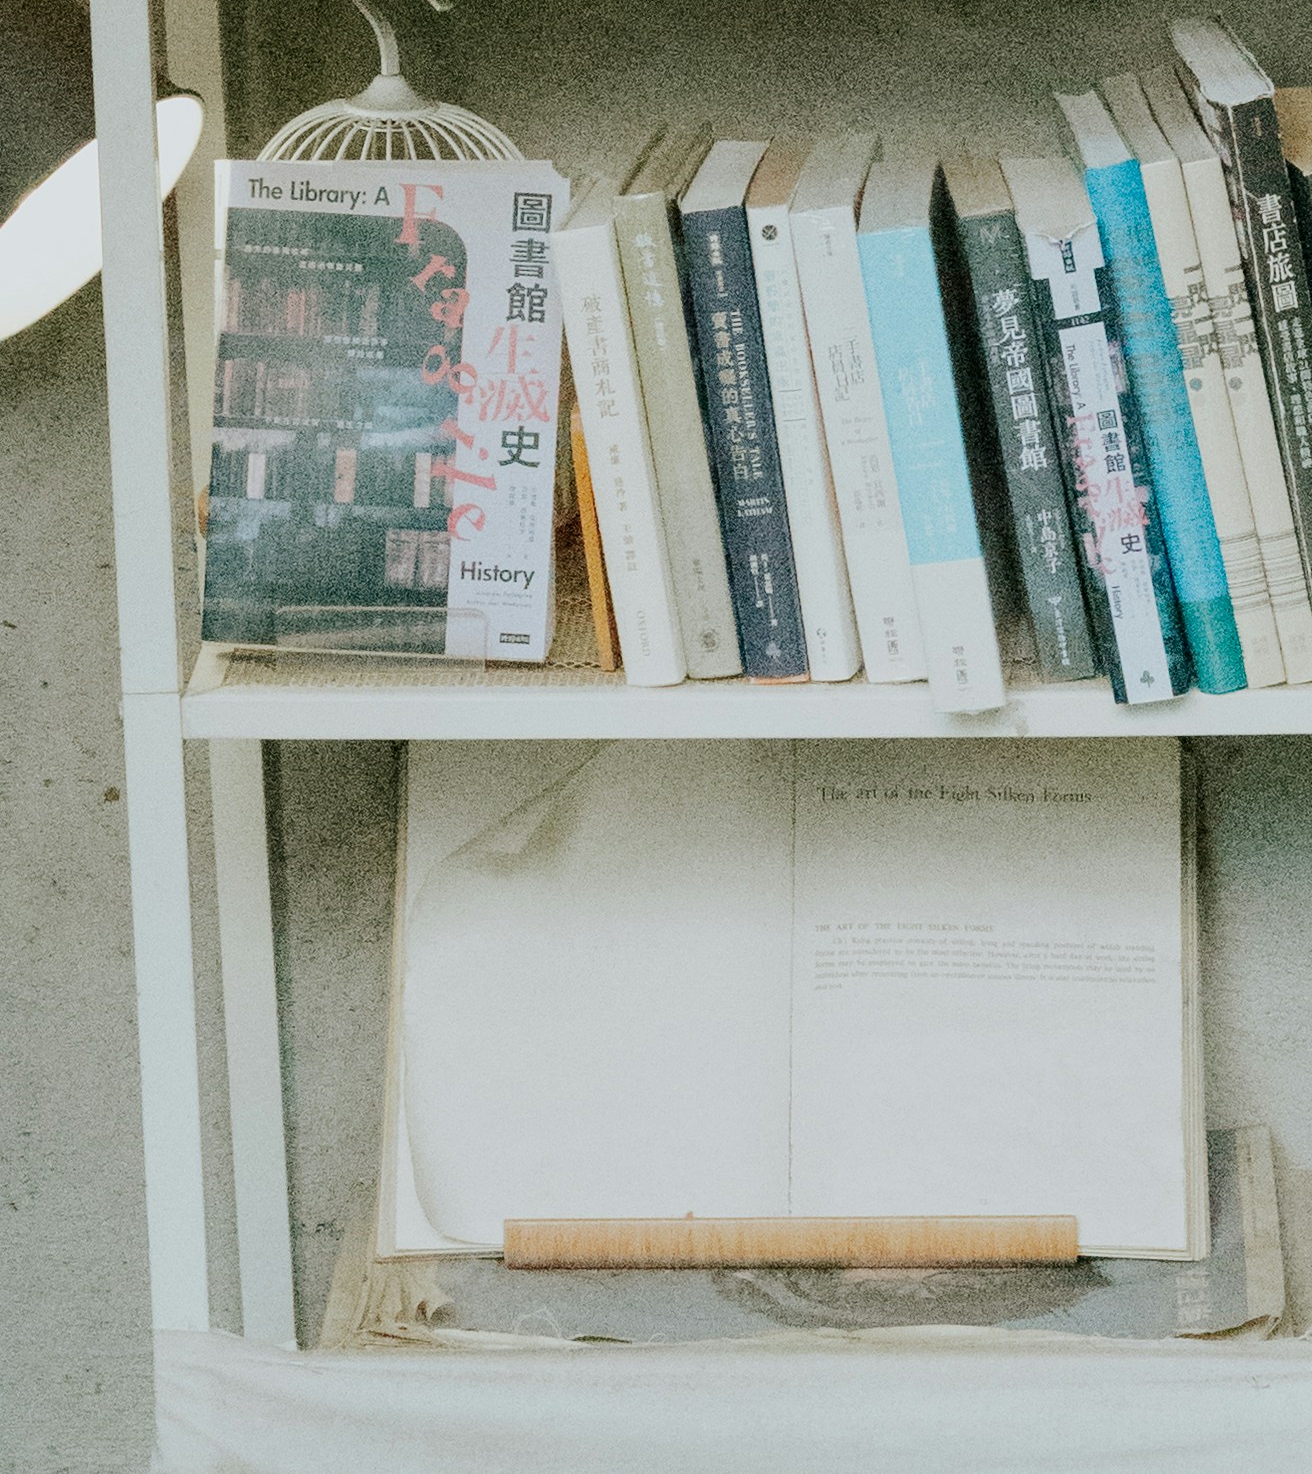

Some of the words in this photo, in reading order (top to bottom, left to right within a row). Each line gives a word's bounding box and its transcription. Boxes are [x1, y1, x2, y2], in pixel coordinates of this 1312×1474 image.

[249, 178, 283, 201] The
[290, 180, 368, 211] Library:
[374, 186, 391, 207] A
[1256, 192, 1299, 312] 書店旅圖
[477, 191, 554, 470] 圖書館生滅史
[581, 294, 619, 420] 破產書商札記
[990, 287, 1048, 471] 夢見帝國圖書館
[459, 559, 537, 589] History
[1035, 508, 1060, 575] 中島京子
[1110, 583, 1124, 622] History
